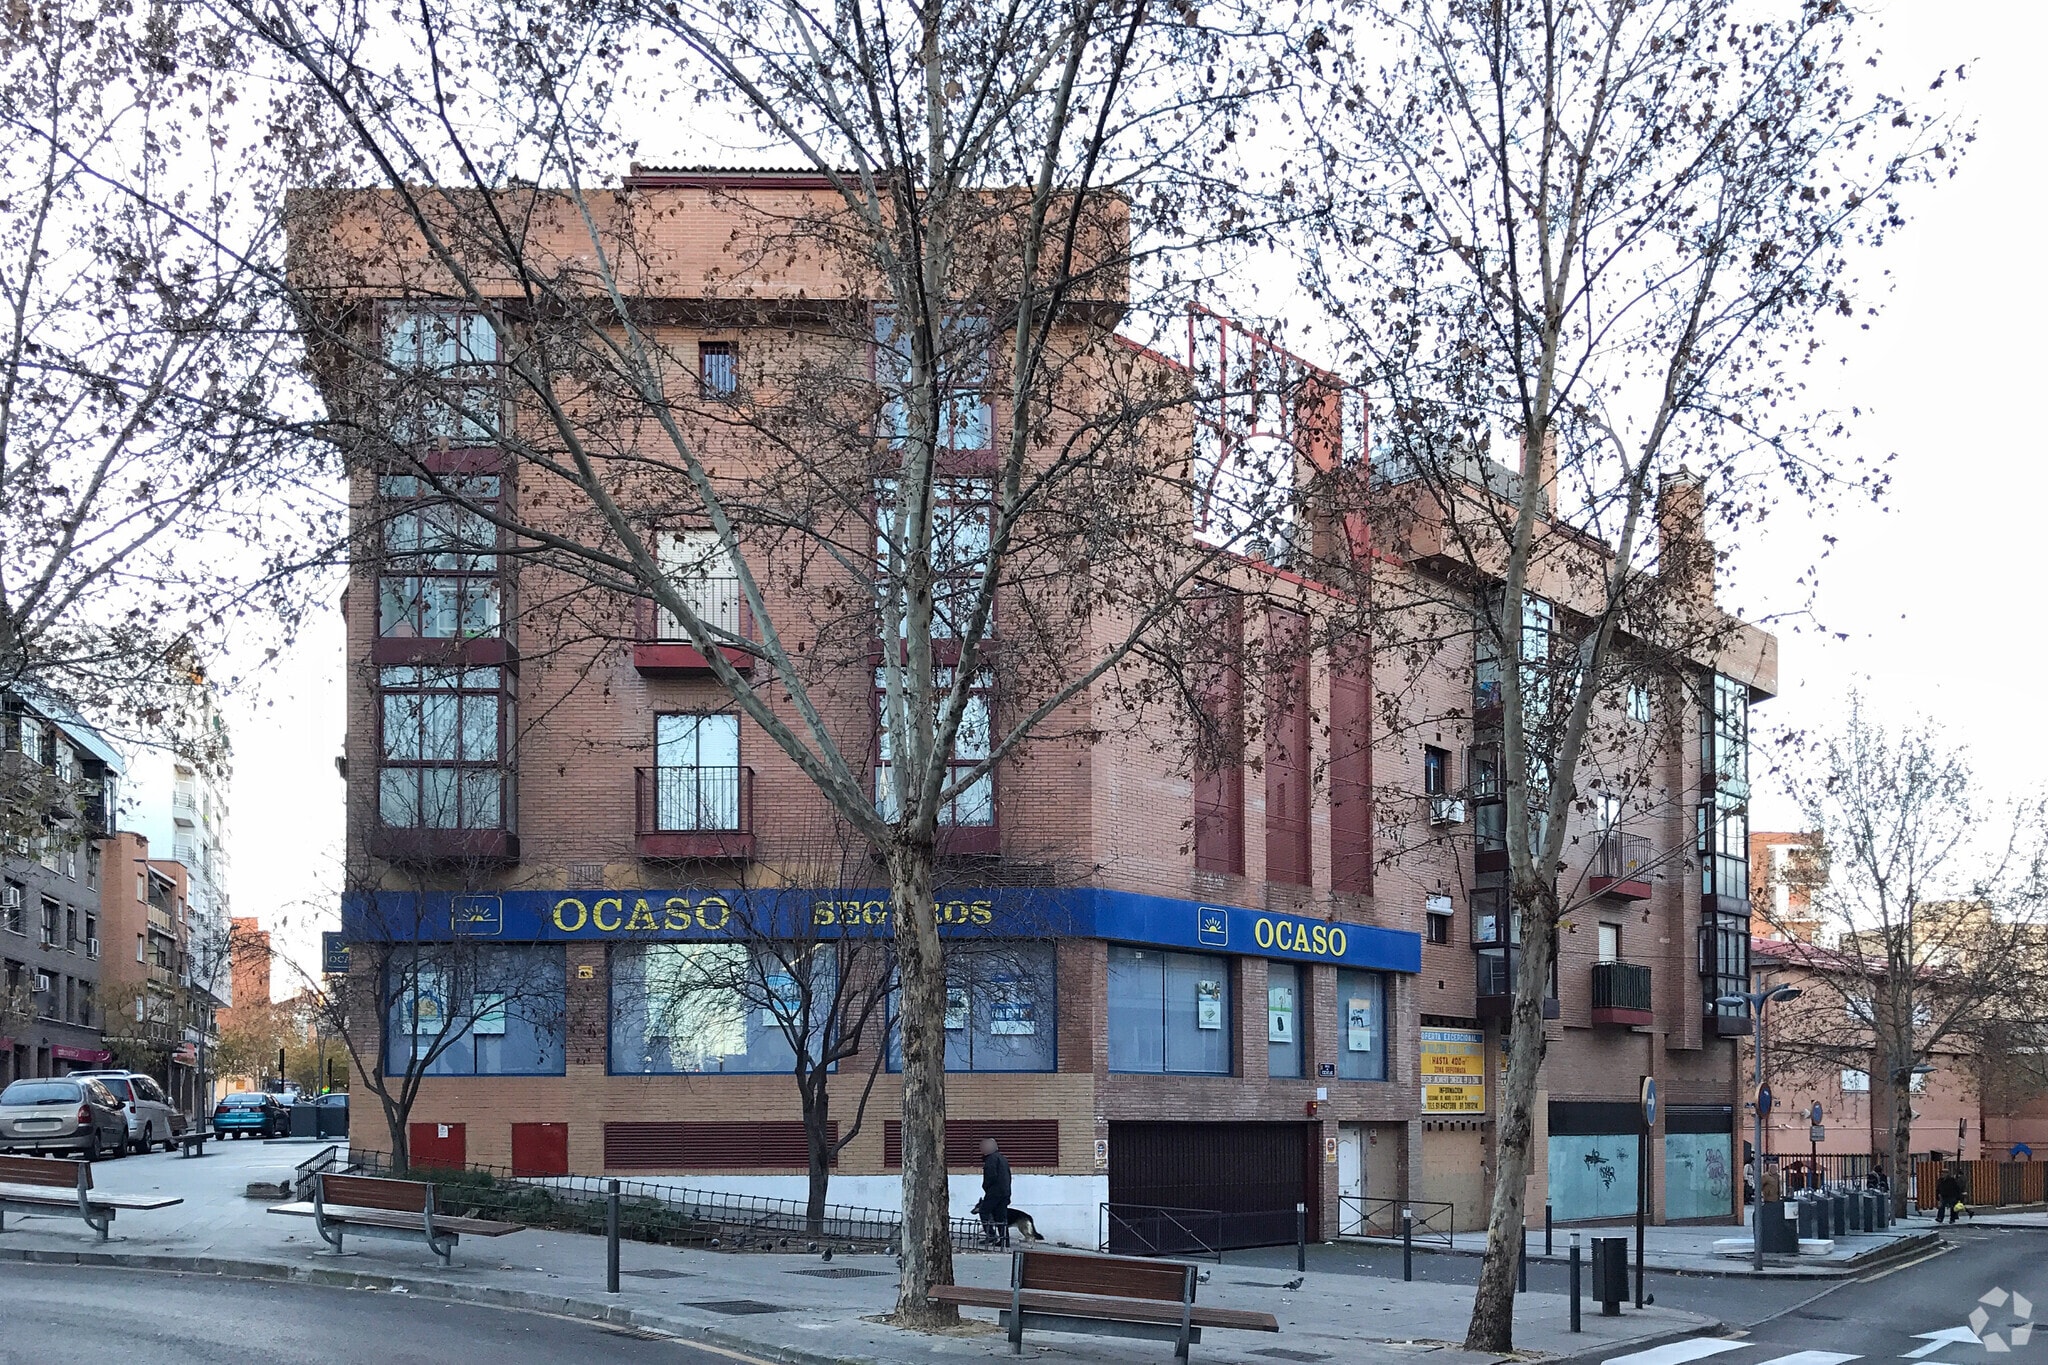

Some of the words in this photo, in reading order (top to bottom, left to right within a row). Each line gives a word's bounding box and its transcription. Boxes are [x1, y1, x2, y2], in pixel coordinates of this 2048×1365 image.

[552, 897, 731, 931] OCASO
[813, 900, 993, 925] SEGOS
[1254, 918, 1347, 956] OCASO
